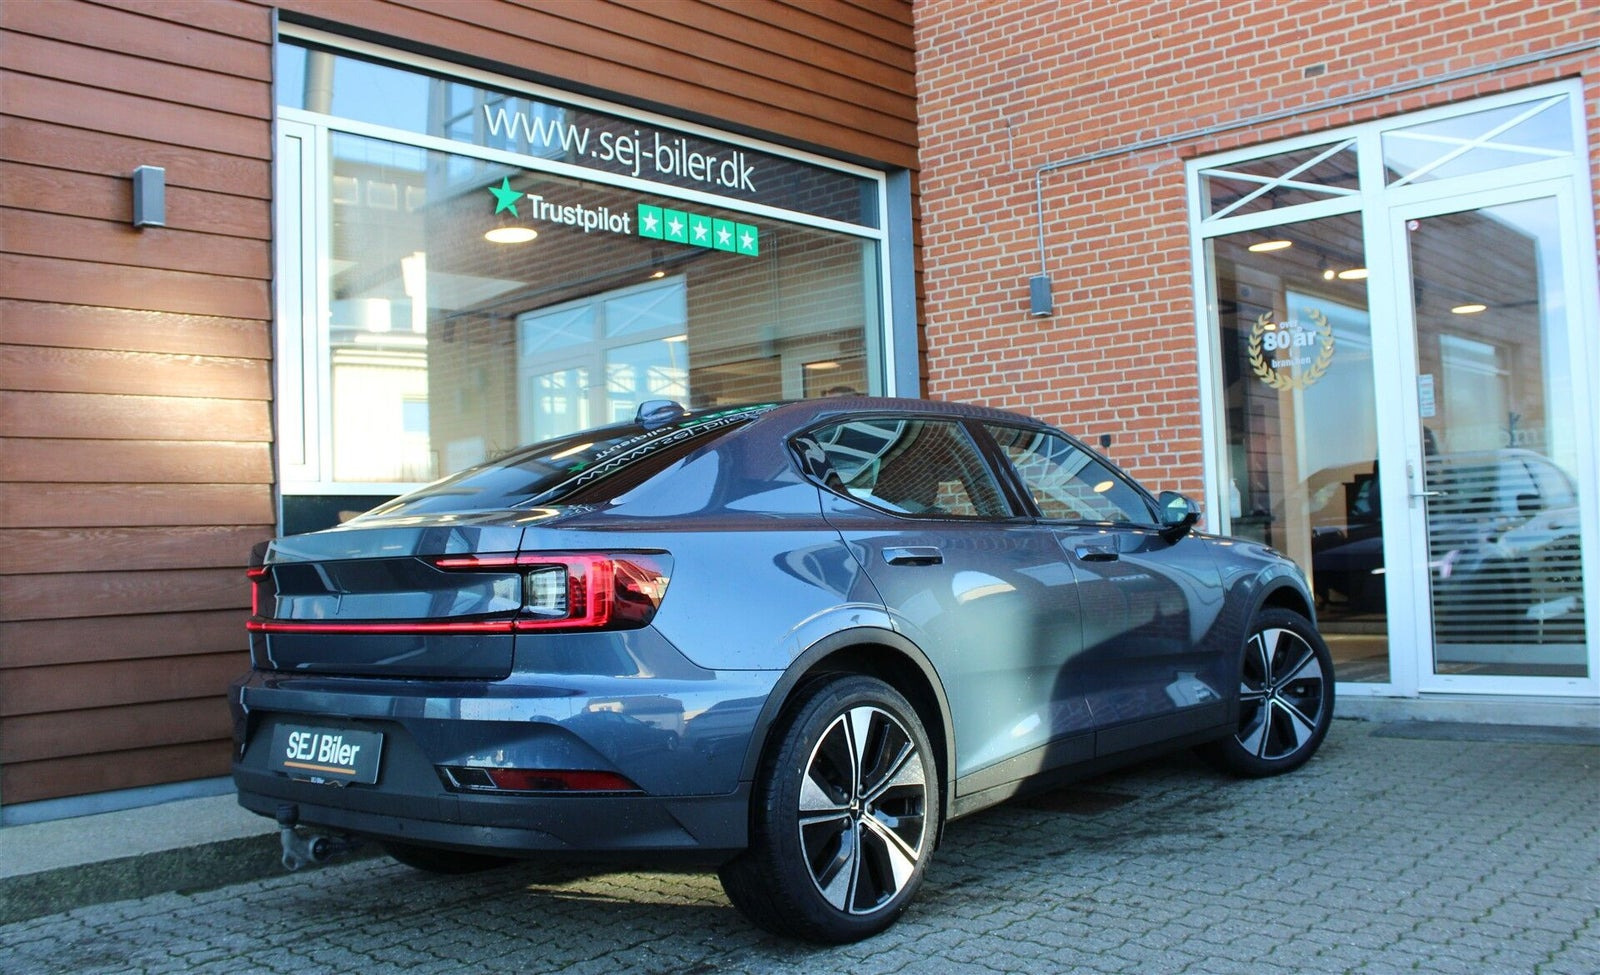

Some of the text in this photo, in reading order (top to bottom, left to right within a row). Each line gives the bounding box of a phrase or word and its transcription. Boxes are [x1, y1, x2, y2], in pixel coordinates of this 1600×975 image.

[483, 104, 756, 192] www.sej-biler.dk
[527, 193, 631, 234] Trustpilot
[1263, 326, 1317, 351] 80 år
[286, 731, 360, 766] SEJ Biler
